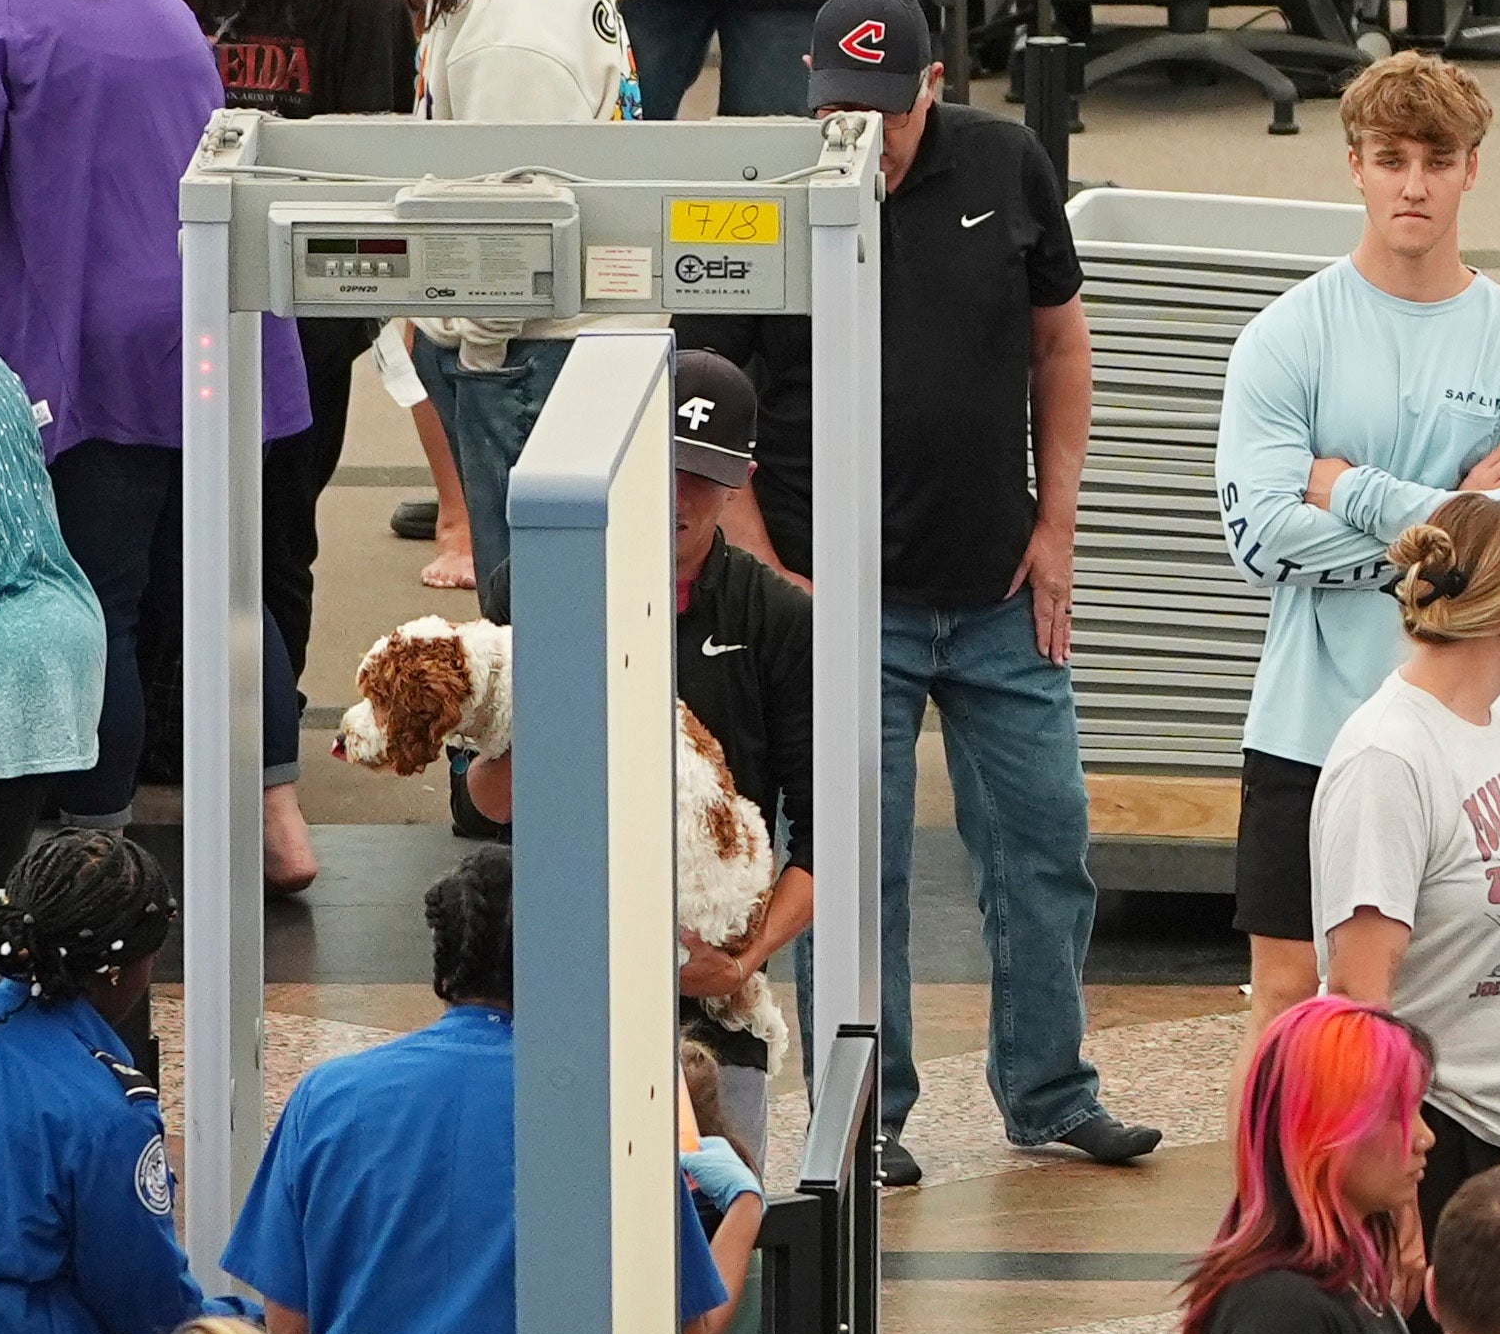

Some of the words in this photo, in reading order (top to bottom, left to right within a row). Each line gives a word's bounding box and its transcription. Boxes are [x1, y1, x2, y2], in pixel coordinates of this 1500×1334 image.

[212, 43, 311, 94] ELDA
[687, 203, 760, 240] 7/8
[1221, 482, 1303, 583] SALT
[1318, 560, 1391, 585] LIF
